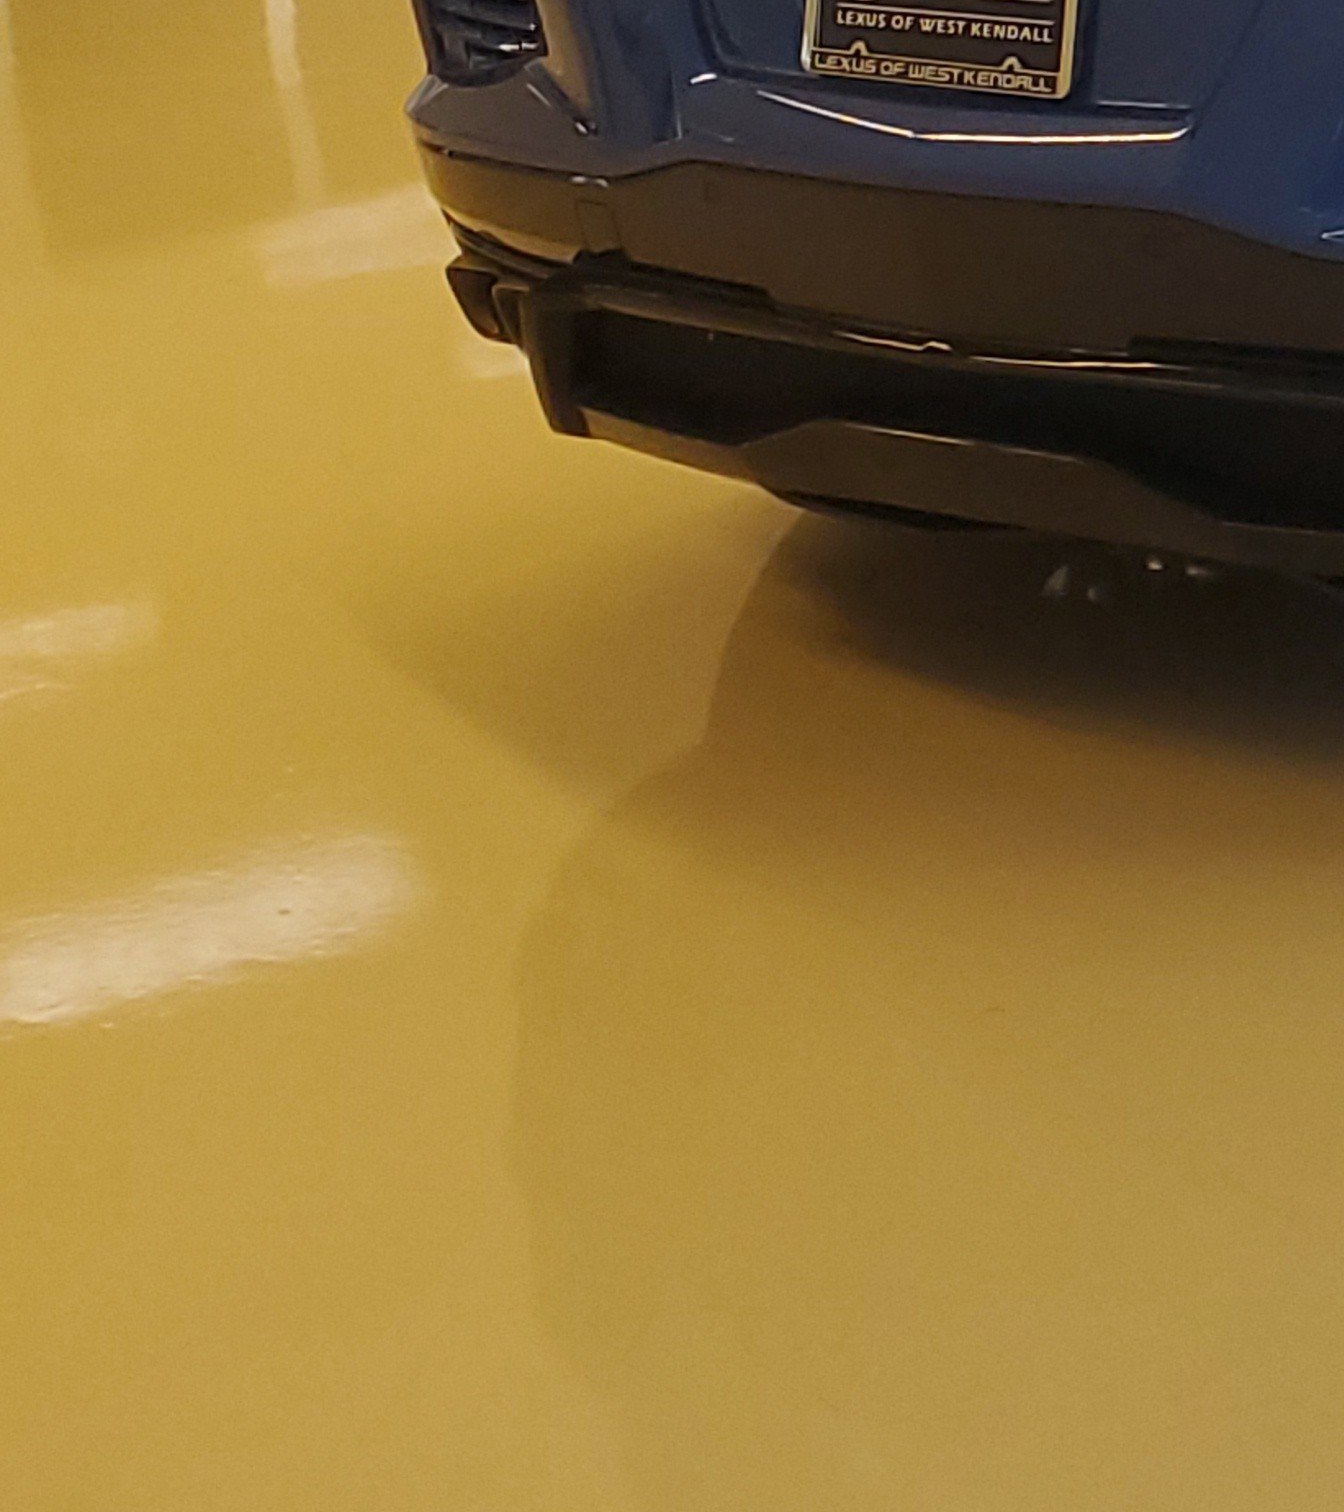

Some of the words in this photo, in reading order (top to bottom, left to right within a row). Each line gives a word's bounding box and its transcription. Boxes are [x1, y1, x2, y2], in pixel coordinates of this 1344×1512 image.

[836, 9, 887, 28] LEXUS
[891, 14, 915, 30] OF
[919, 18, 966, 34] WEST
[970, 22, 1054, 43] KENDALL
[815, 53, 876, 73] LEXUS
[880, 61, 906, 75] OF
[908, 64, 961, 84] WEST
[963, 70, 1053, 92] KENDALL
